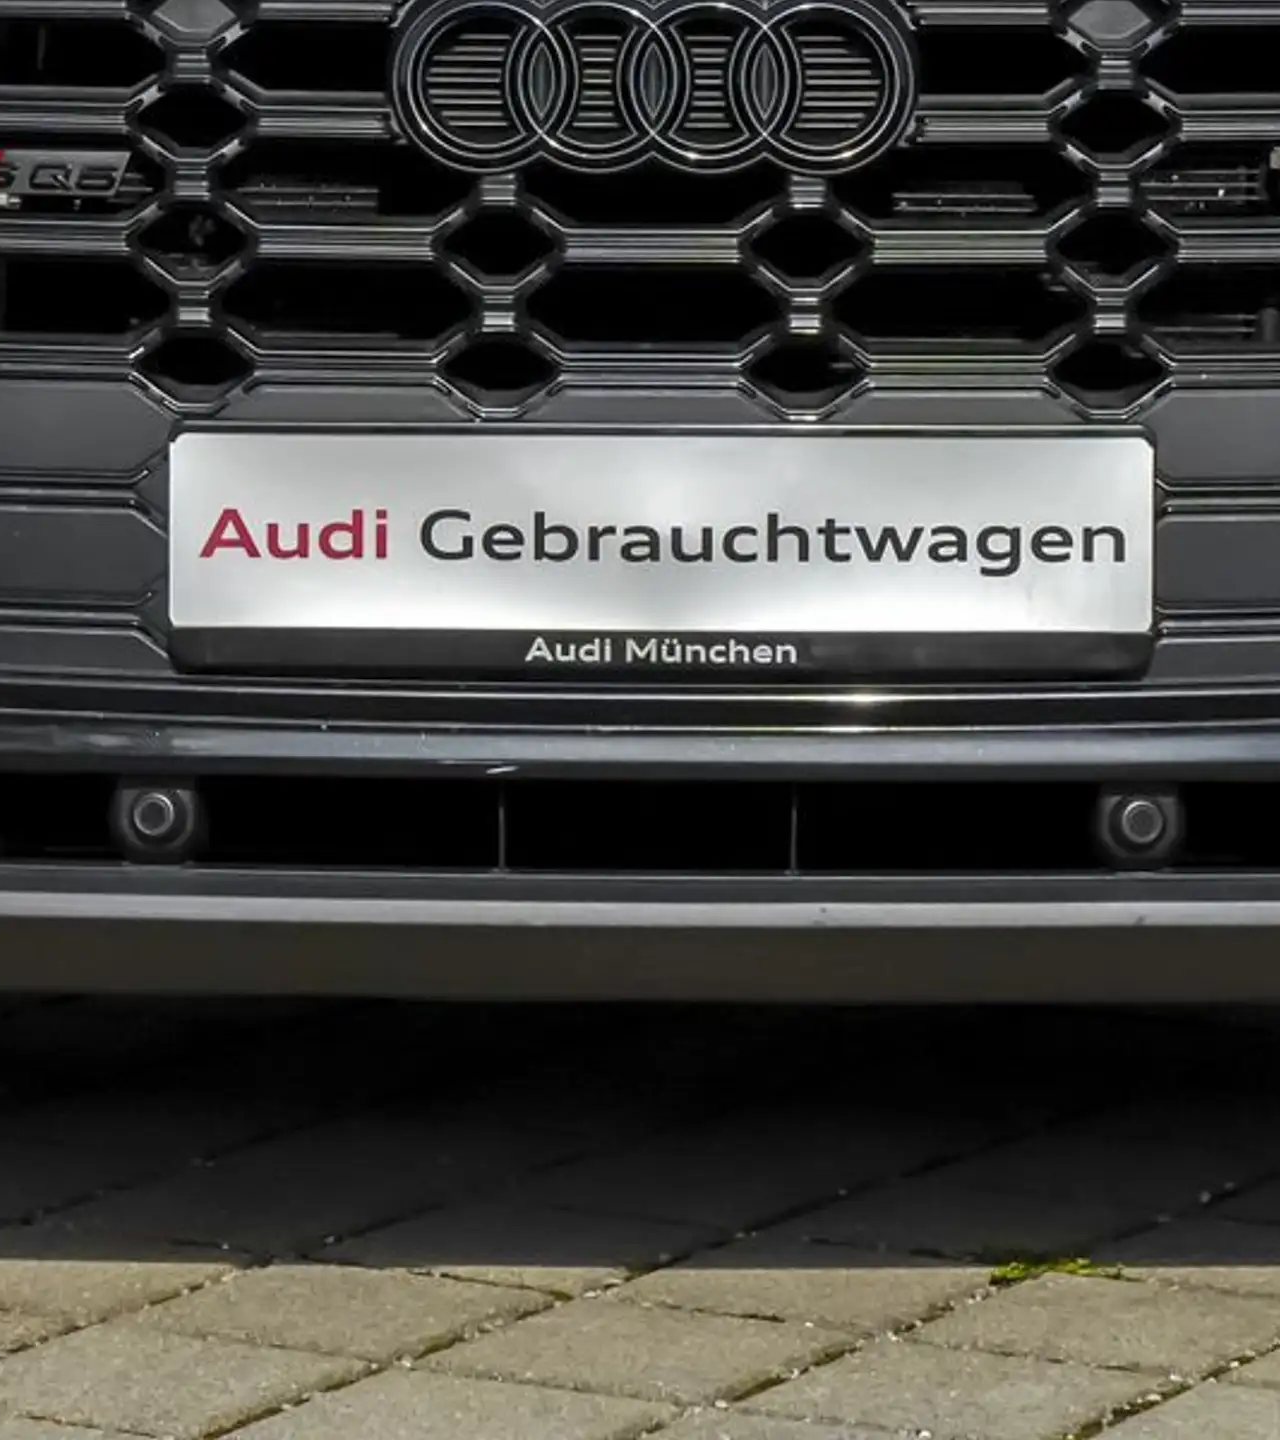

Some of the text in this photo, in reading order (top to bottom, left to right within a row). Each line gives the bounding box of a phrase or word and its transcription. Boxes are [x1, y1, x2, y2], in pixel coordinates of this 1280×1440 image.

[198, 507, 1126, 578] Audi Gebrauchtwagen
[523, 632, 799, 665] Audi München
